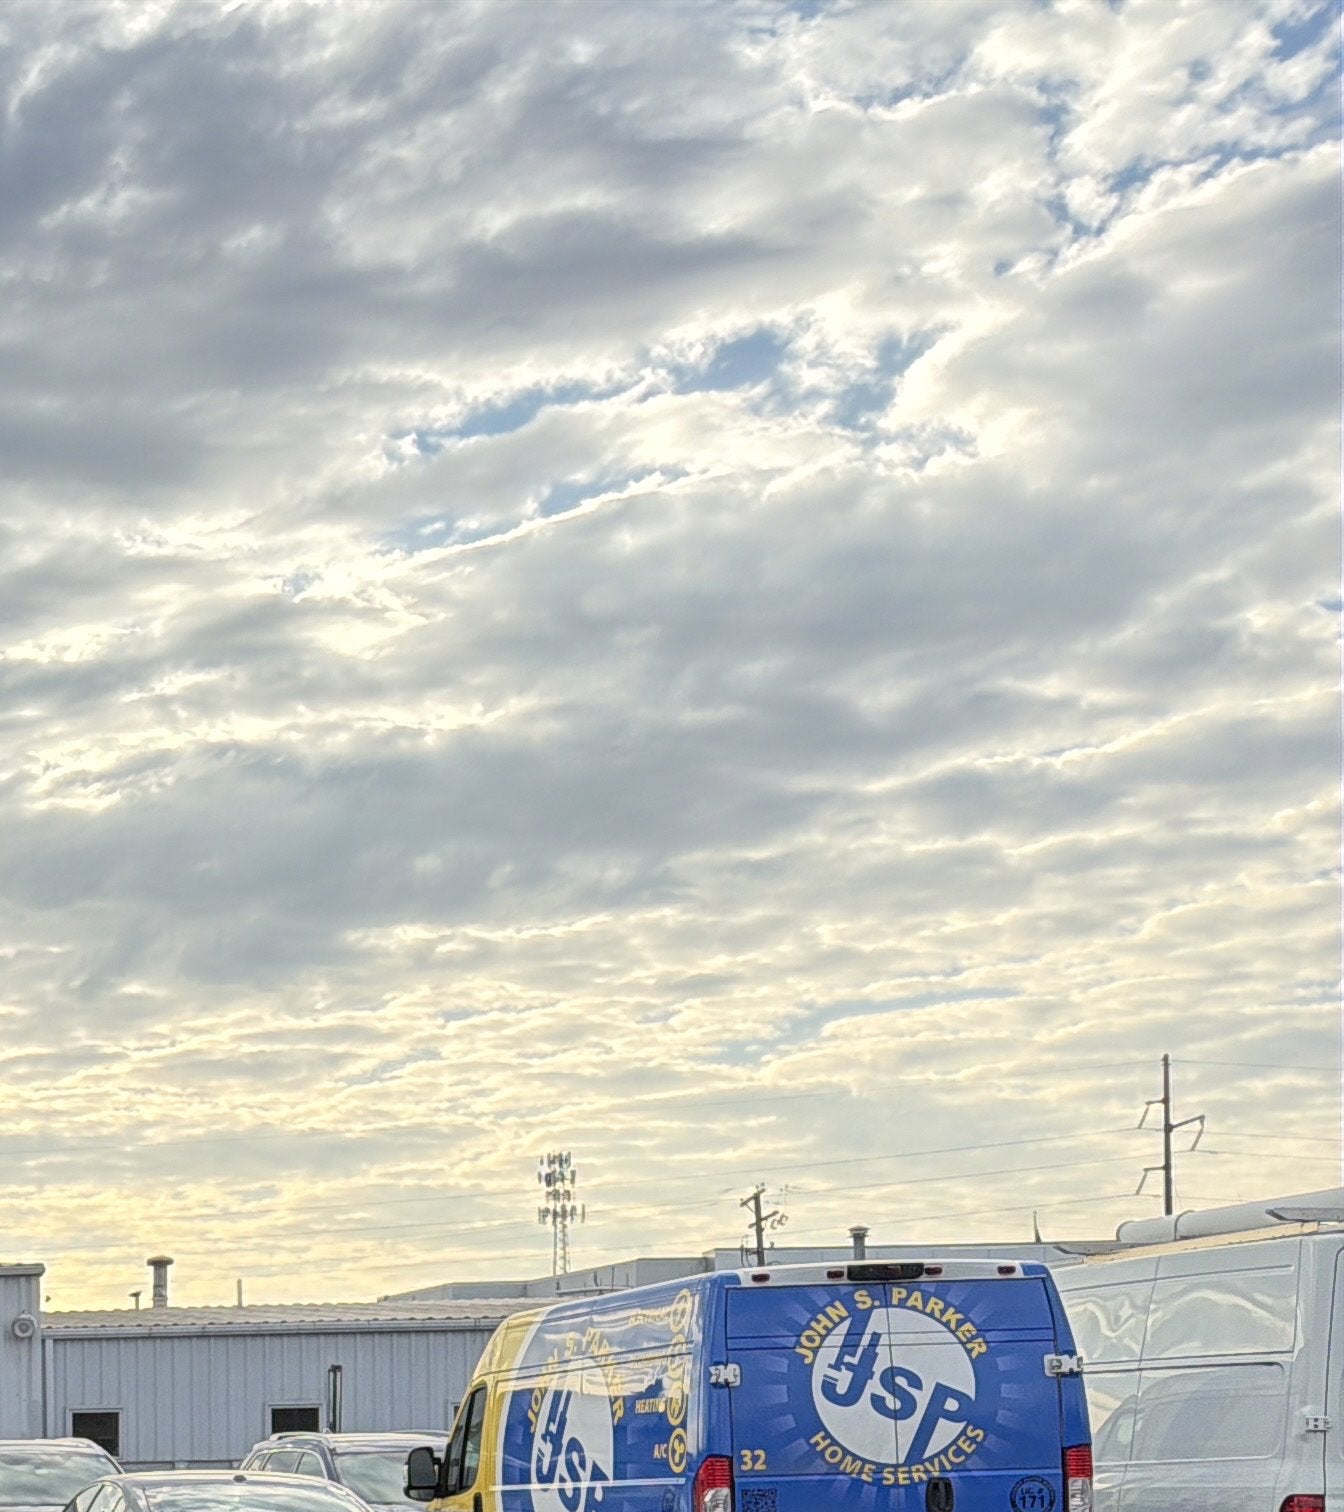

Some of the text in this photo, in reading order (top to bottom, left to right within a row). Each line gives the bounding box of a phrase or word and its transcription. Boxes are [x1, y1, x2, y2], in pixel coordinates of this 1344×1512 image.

[795, 1287, 988, 1365] JOHN S. PARKER
[820, 1322, 978, 1466] JSP
[653, 1443, 668, 1459] A/C
[740, 1449, 767, 1471] 32
[809, 1425, 985, 1486] HOME SERVICES
[1020, 1494, 1045, 1509] 171
